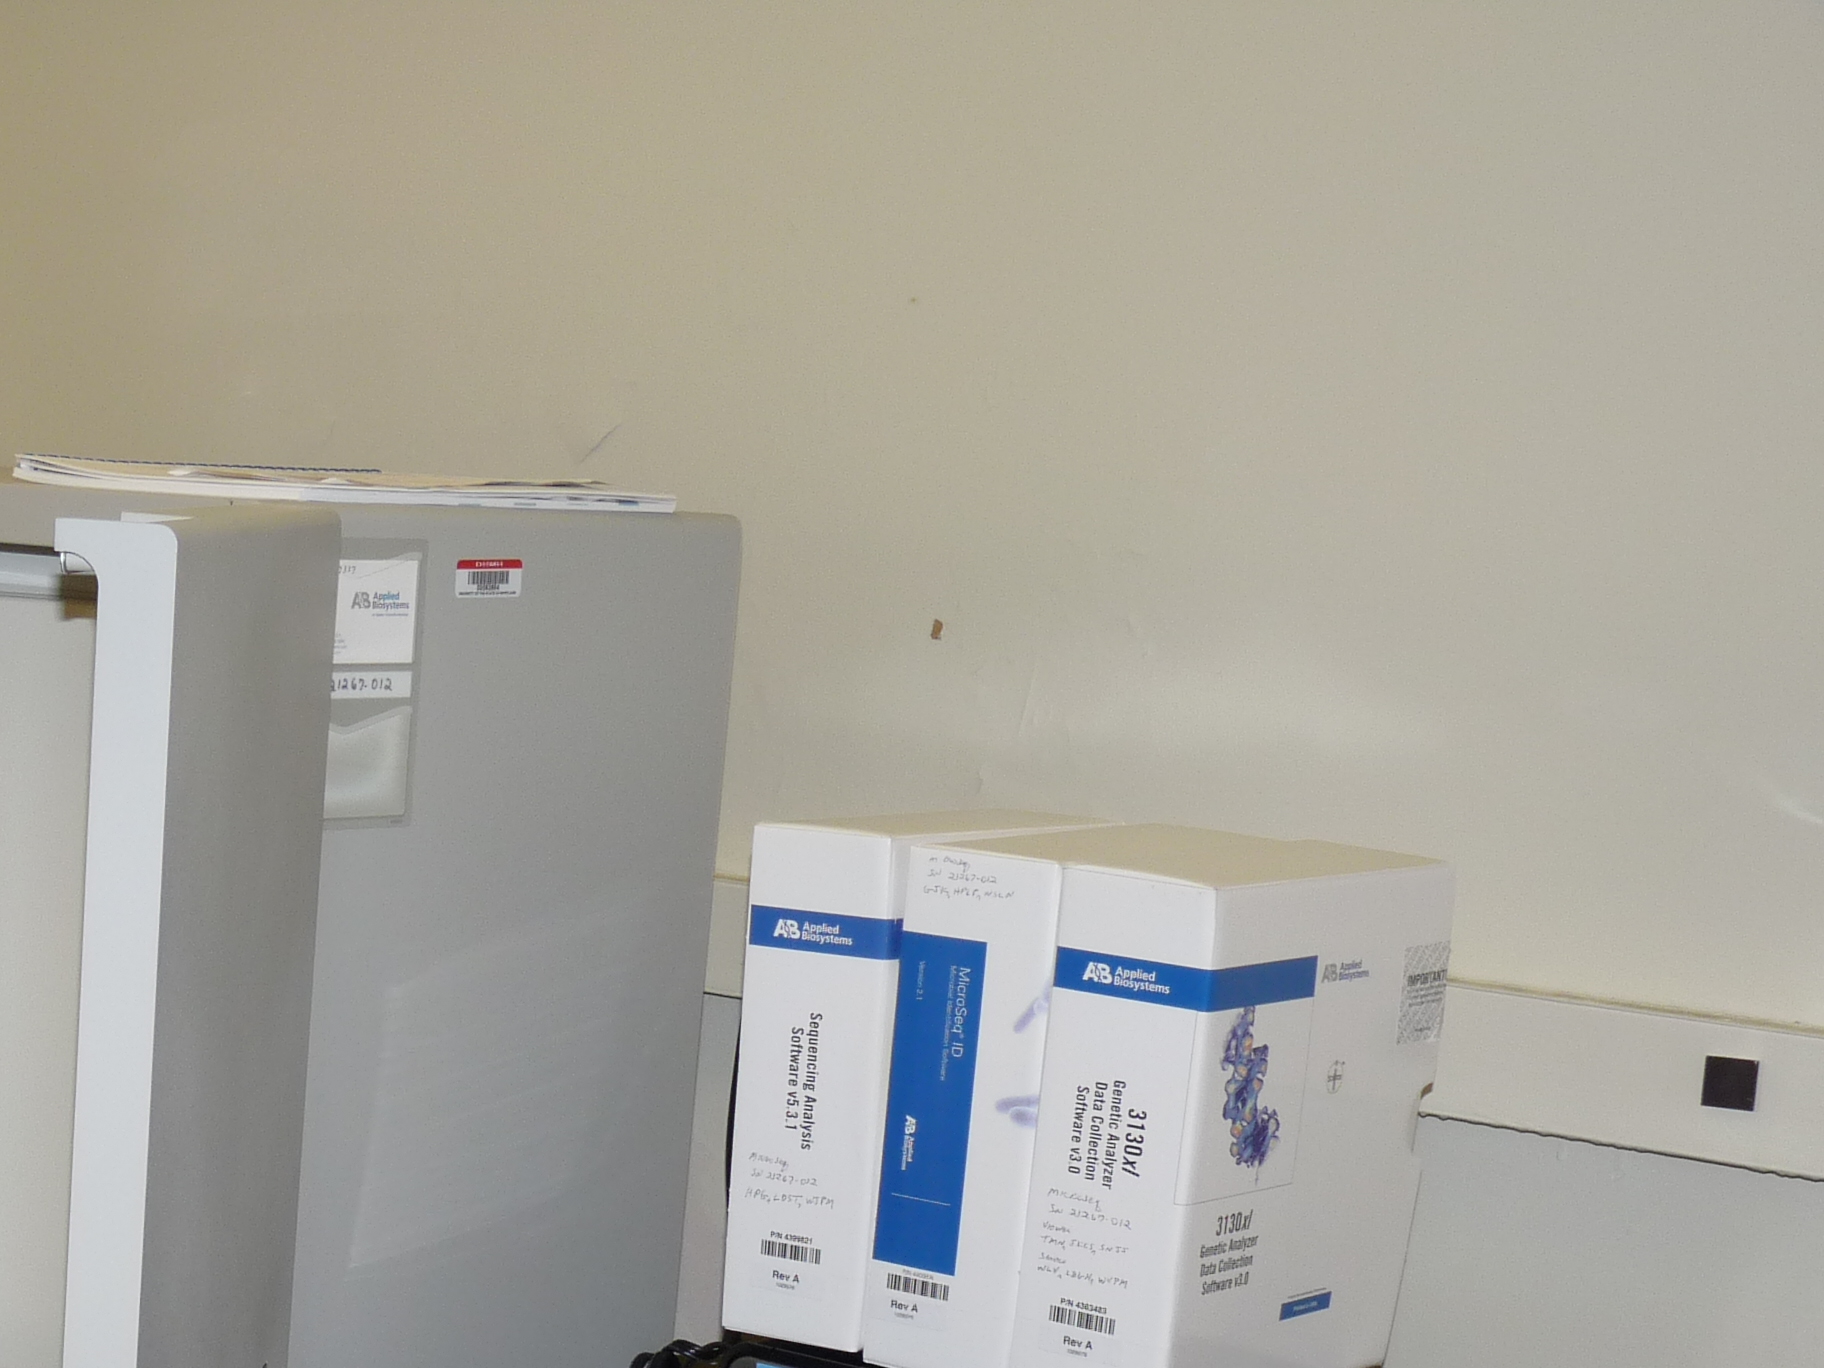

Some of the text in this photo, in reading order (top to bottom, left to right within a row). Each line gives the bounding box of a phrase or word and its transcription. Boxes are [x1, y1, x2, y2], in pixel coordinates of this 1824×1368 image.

[372, 592, 400, 601] Applied
[372, 601, 410, 611] Biosystems
[802, 920, 839, 934] Applied
[802, 932, 854, 946] Biosystems
[1340, 959, 1363, 970] Applied
[916, 960, 926, 1001] Version 2.1
[1114, 966, 1156, 982] Applied
[1114, 976, 1170, 994] Biosystems
[951, 1042, 964, 1058] ID
[784, 1026, 804, 1130] Software v5.3.1
[800, 1012, 823, 1151] Sequencing Analysis
[1068, 1085, 1090, 1176] Software v3.0
[1084, 1081, 1108, 1182] Data Collection
[1101, 1080, 1126, 1190] Genetic Analyzer
[1200, 1235, 1259, 1258] Genetic Analyzer
[1200, 1254, 1254, 1278] Data Collection
[772, 1270, 800, 1284] Rev A
[1201, 1271, 1250, 1296] Software v3.0
[890, 1300, 918, 1314] Rev A
[1060, 1298, 1074, 1308] P/N
[1063, 1336, 1094, 1350] Rev A
